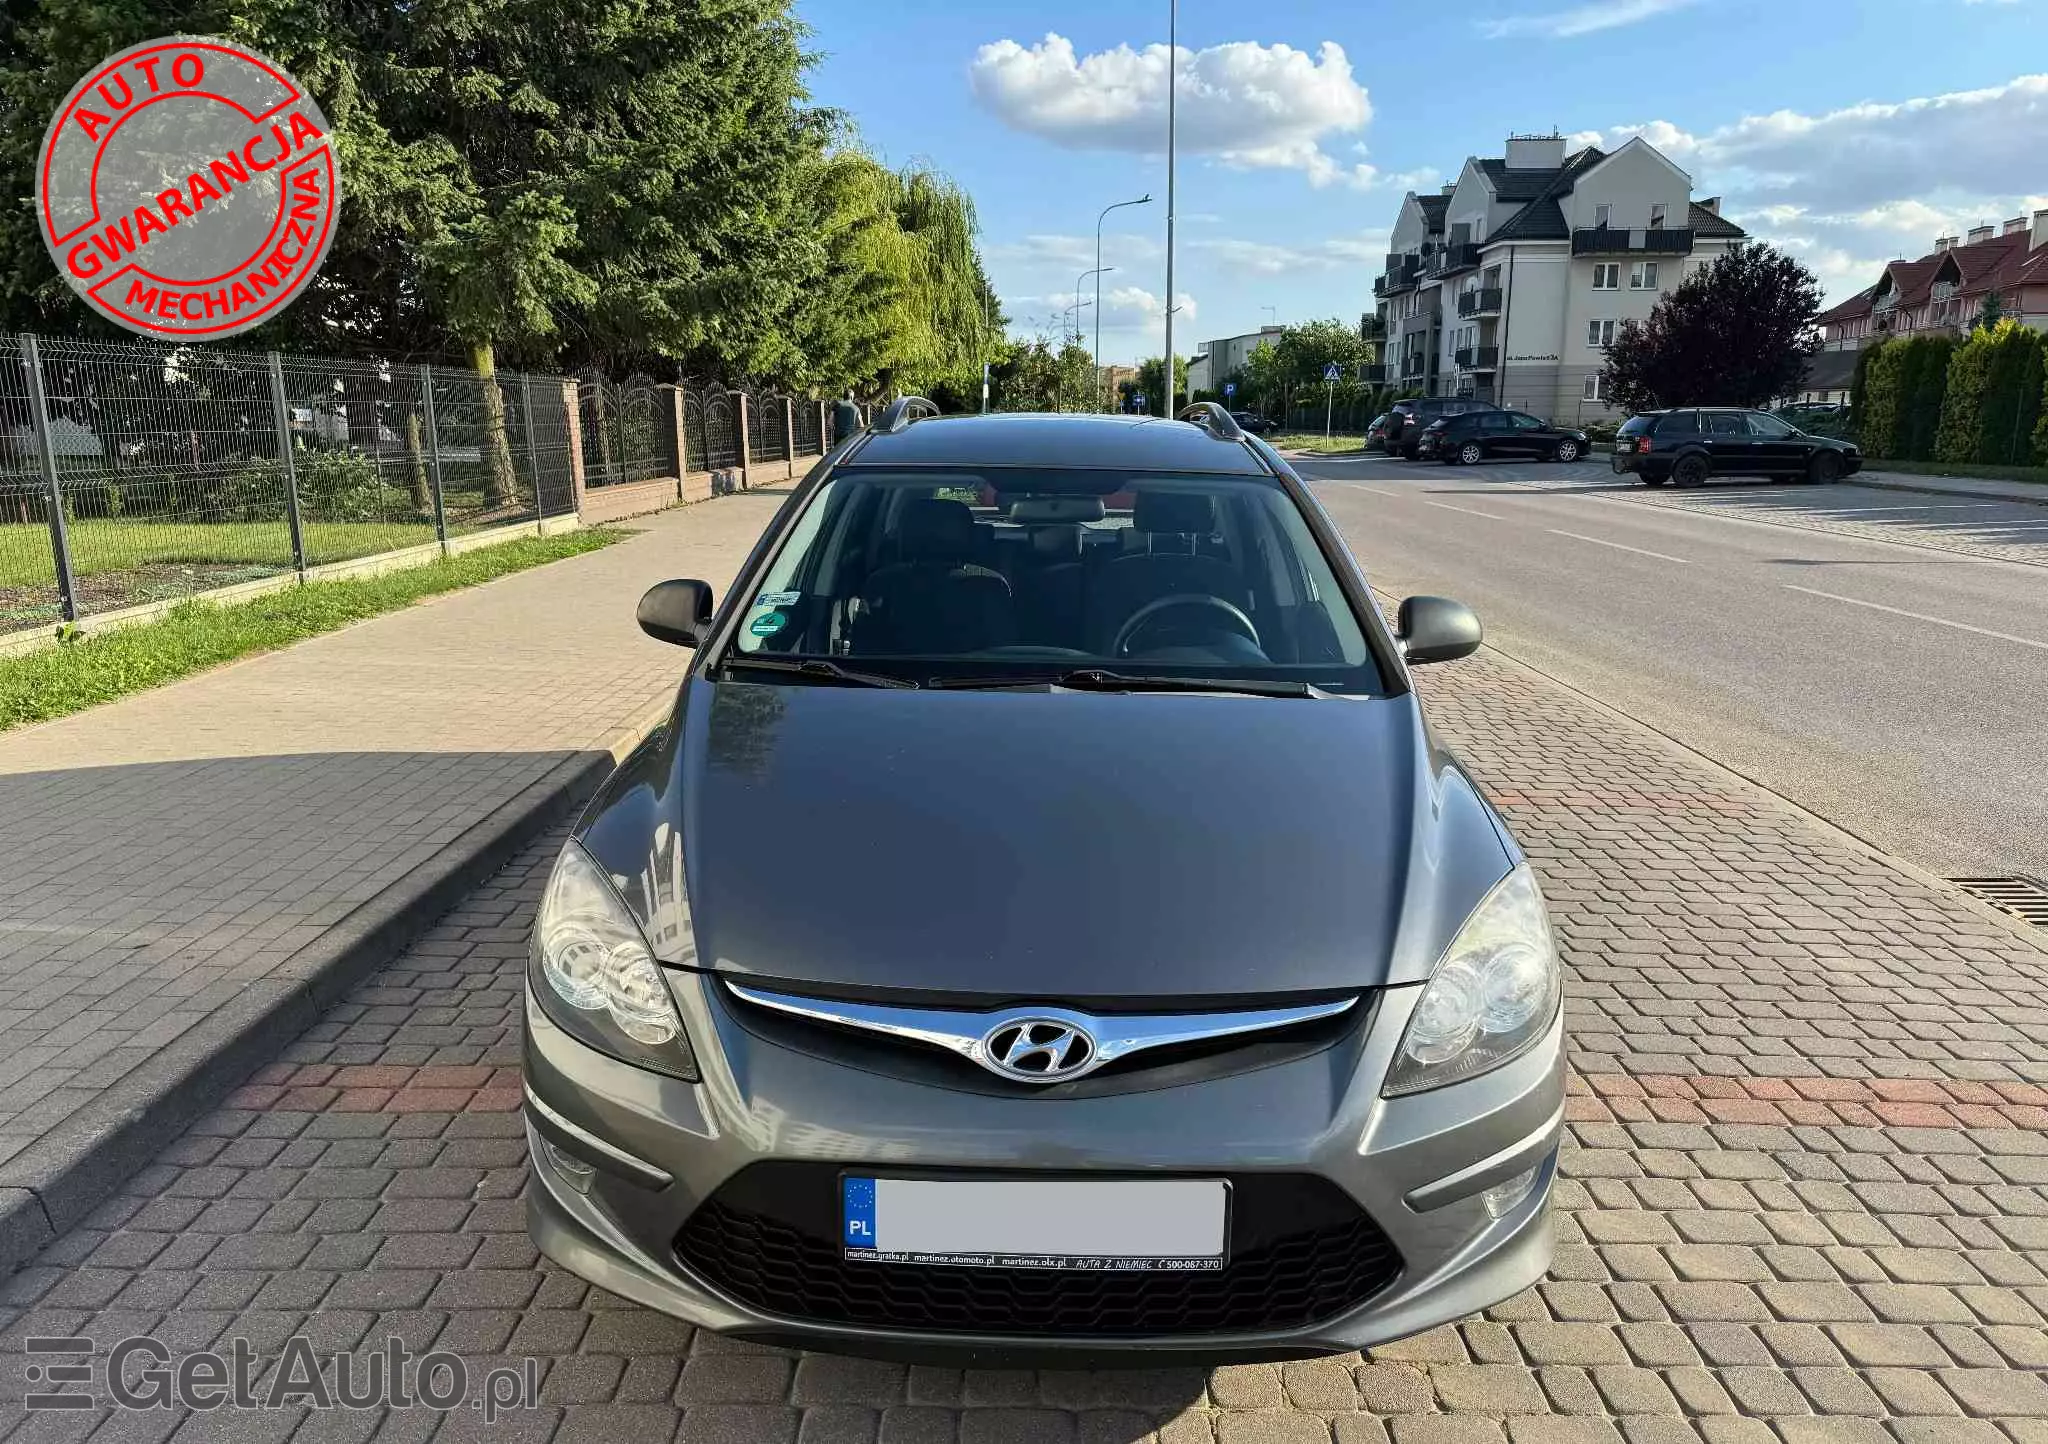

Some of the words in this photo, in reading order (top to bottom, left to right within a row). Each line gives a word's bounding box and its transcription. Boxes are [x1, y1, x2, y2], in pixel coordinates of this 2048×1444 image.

[850, 1220, 872, 1235] PL
[914, 1254, 994, 1266] martinez.otomoto.pl
[1002, 1256, 1066, 1269] martinez.olx.pl
[1076, 1259, 1101, 1269] AUTA
[1116, 1259, 1153, 1269] NIEMIEC
